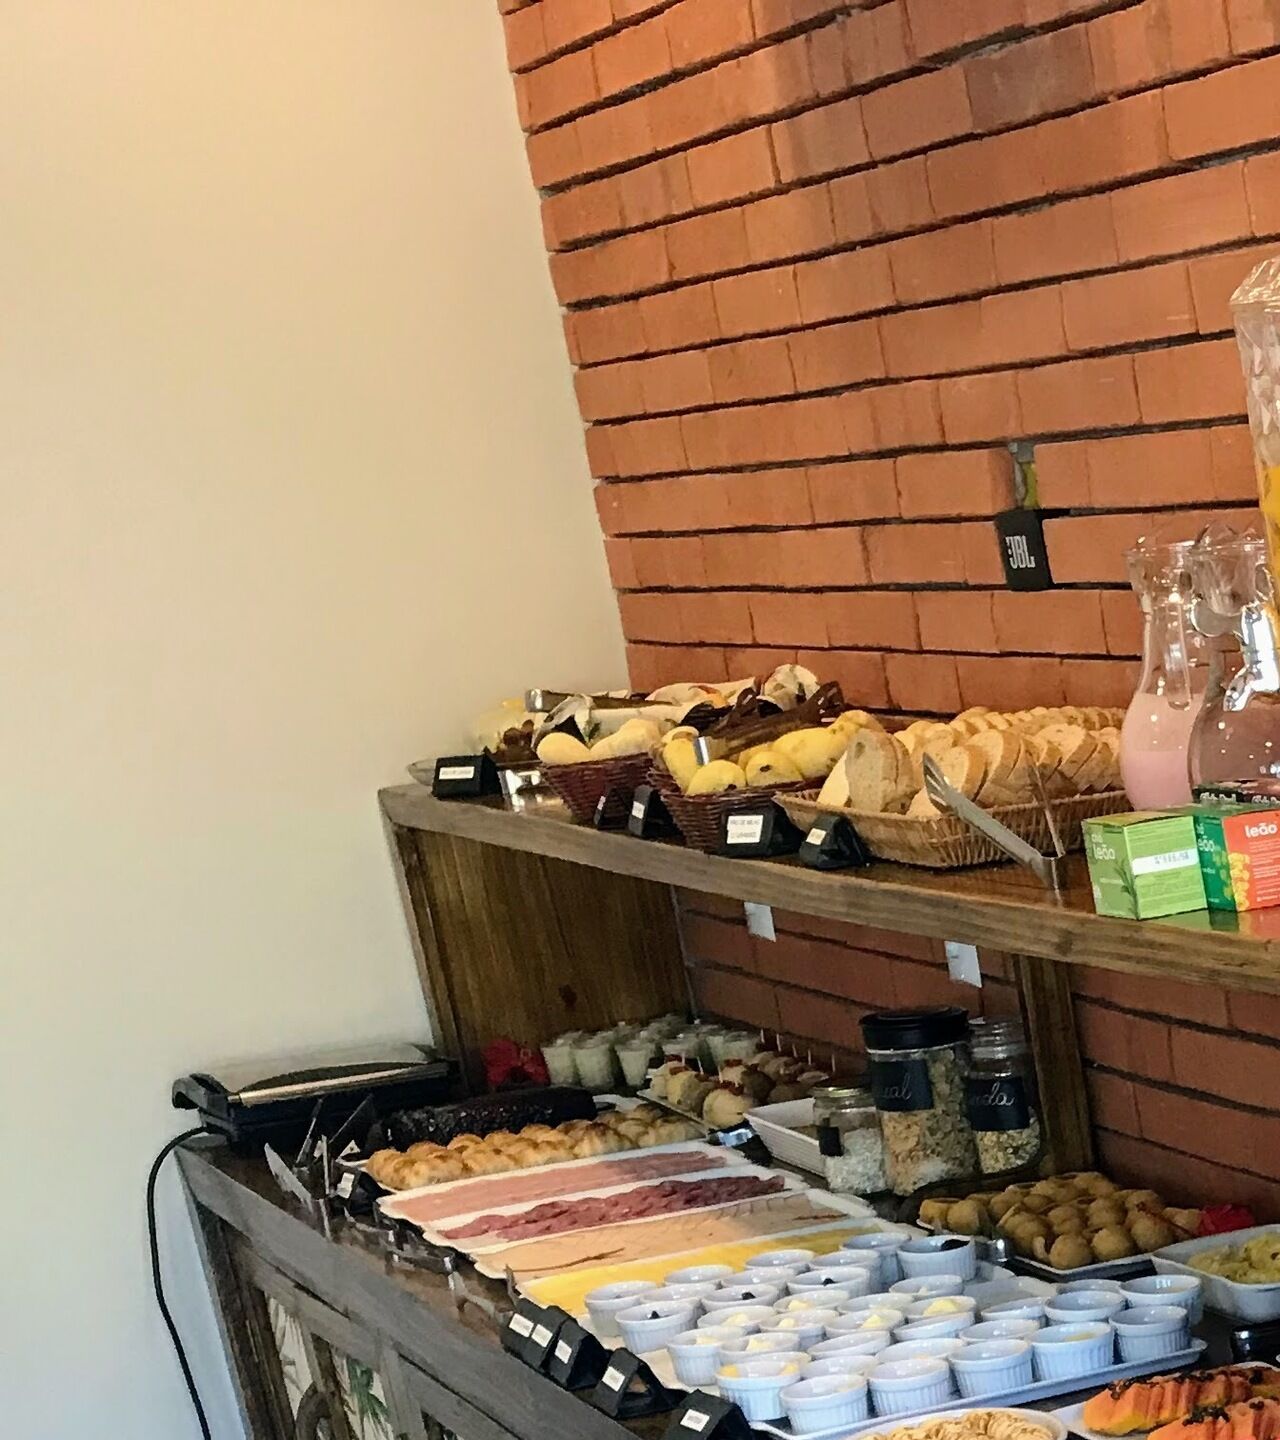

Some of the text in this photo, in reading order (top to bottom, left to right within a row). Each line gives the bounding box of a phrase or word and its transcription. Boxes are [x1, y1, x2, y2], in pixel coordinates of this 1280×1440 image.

[1005, 535, 1036, 569] JBL
[1244, 822, 1278, 838] leão
[1092, 843, 1116, 860] leão
